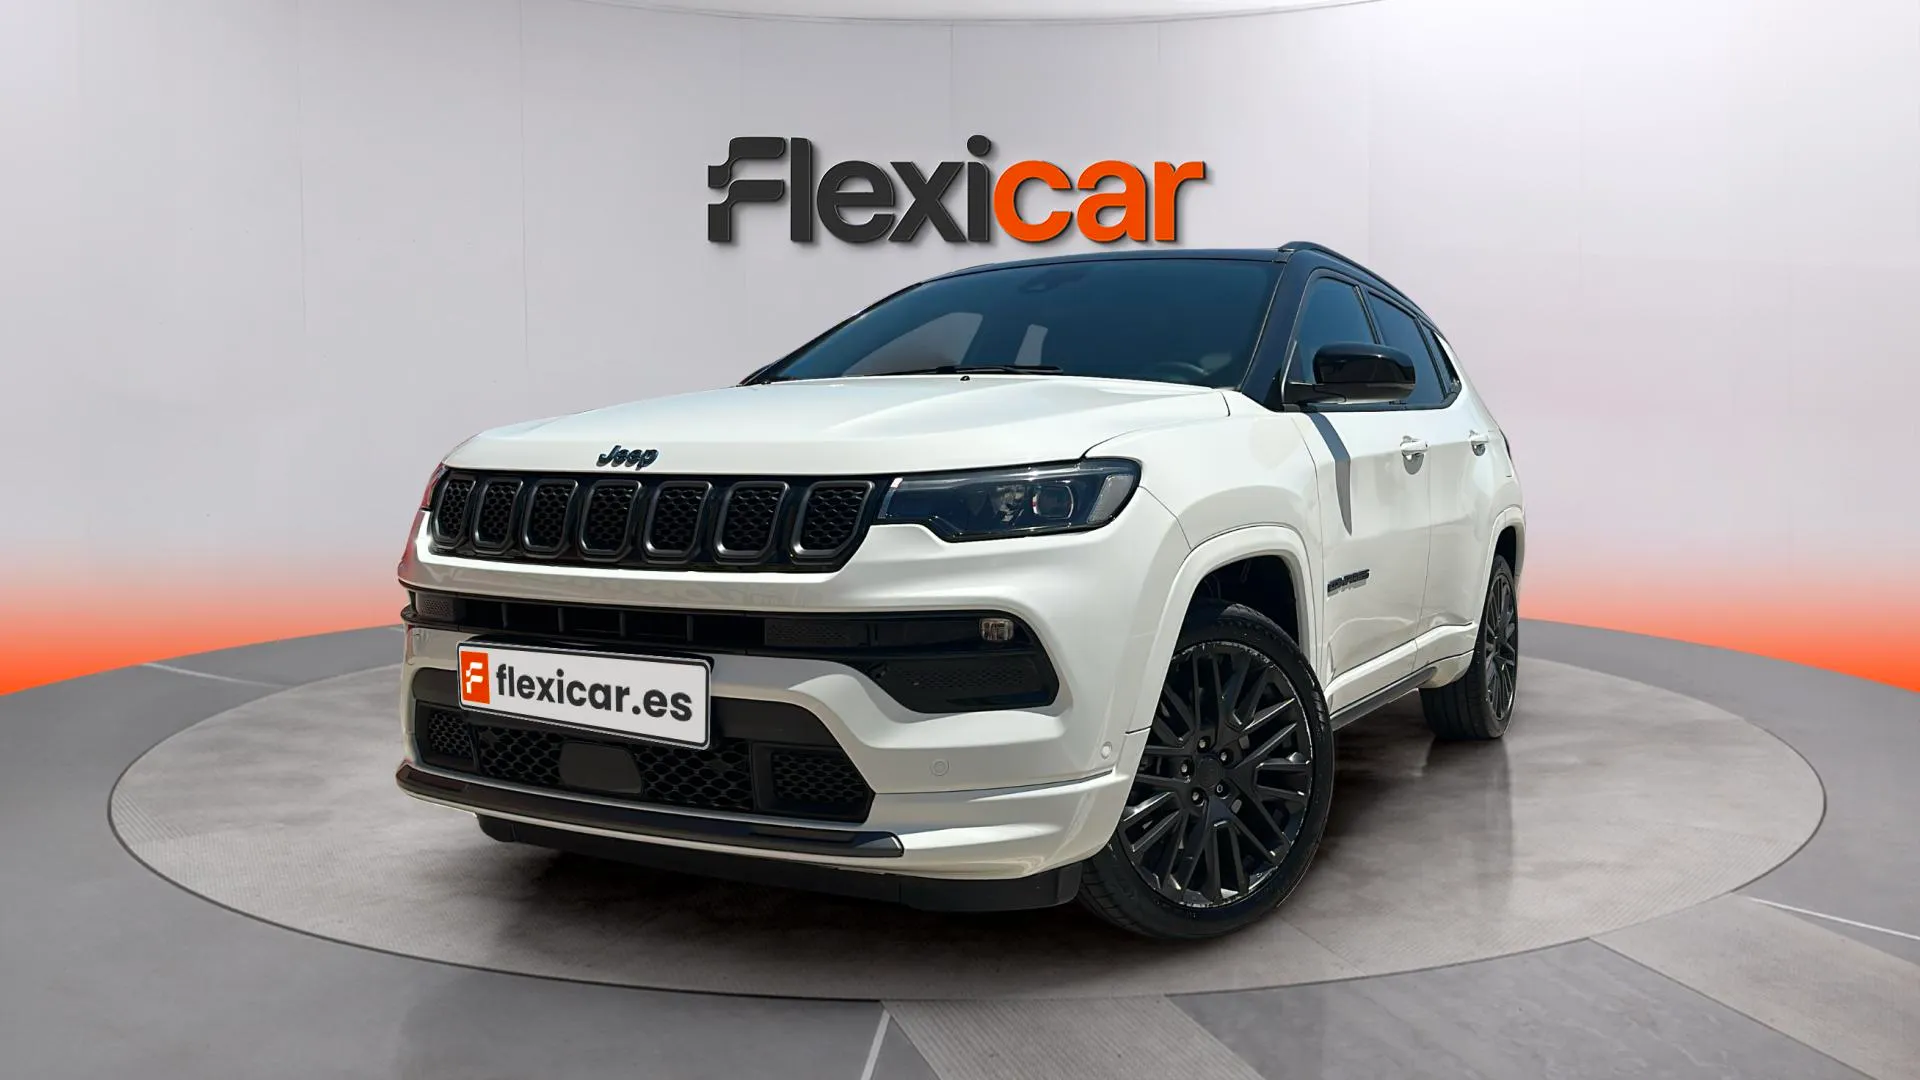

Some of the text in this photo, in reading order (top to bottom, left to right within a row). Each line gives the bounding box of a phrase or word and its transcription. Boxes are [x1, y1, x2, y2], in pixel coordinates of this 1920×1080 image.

[707, 134, 1207, 243] Flexicar
[596, 445, 659, 471] Jeep
[496, 664, 693, 722] flexicar.es
